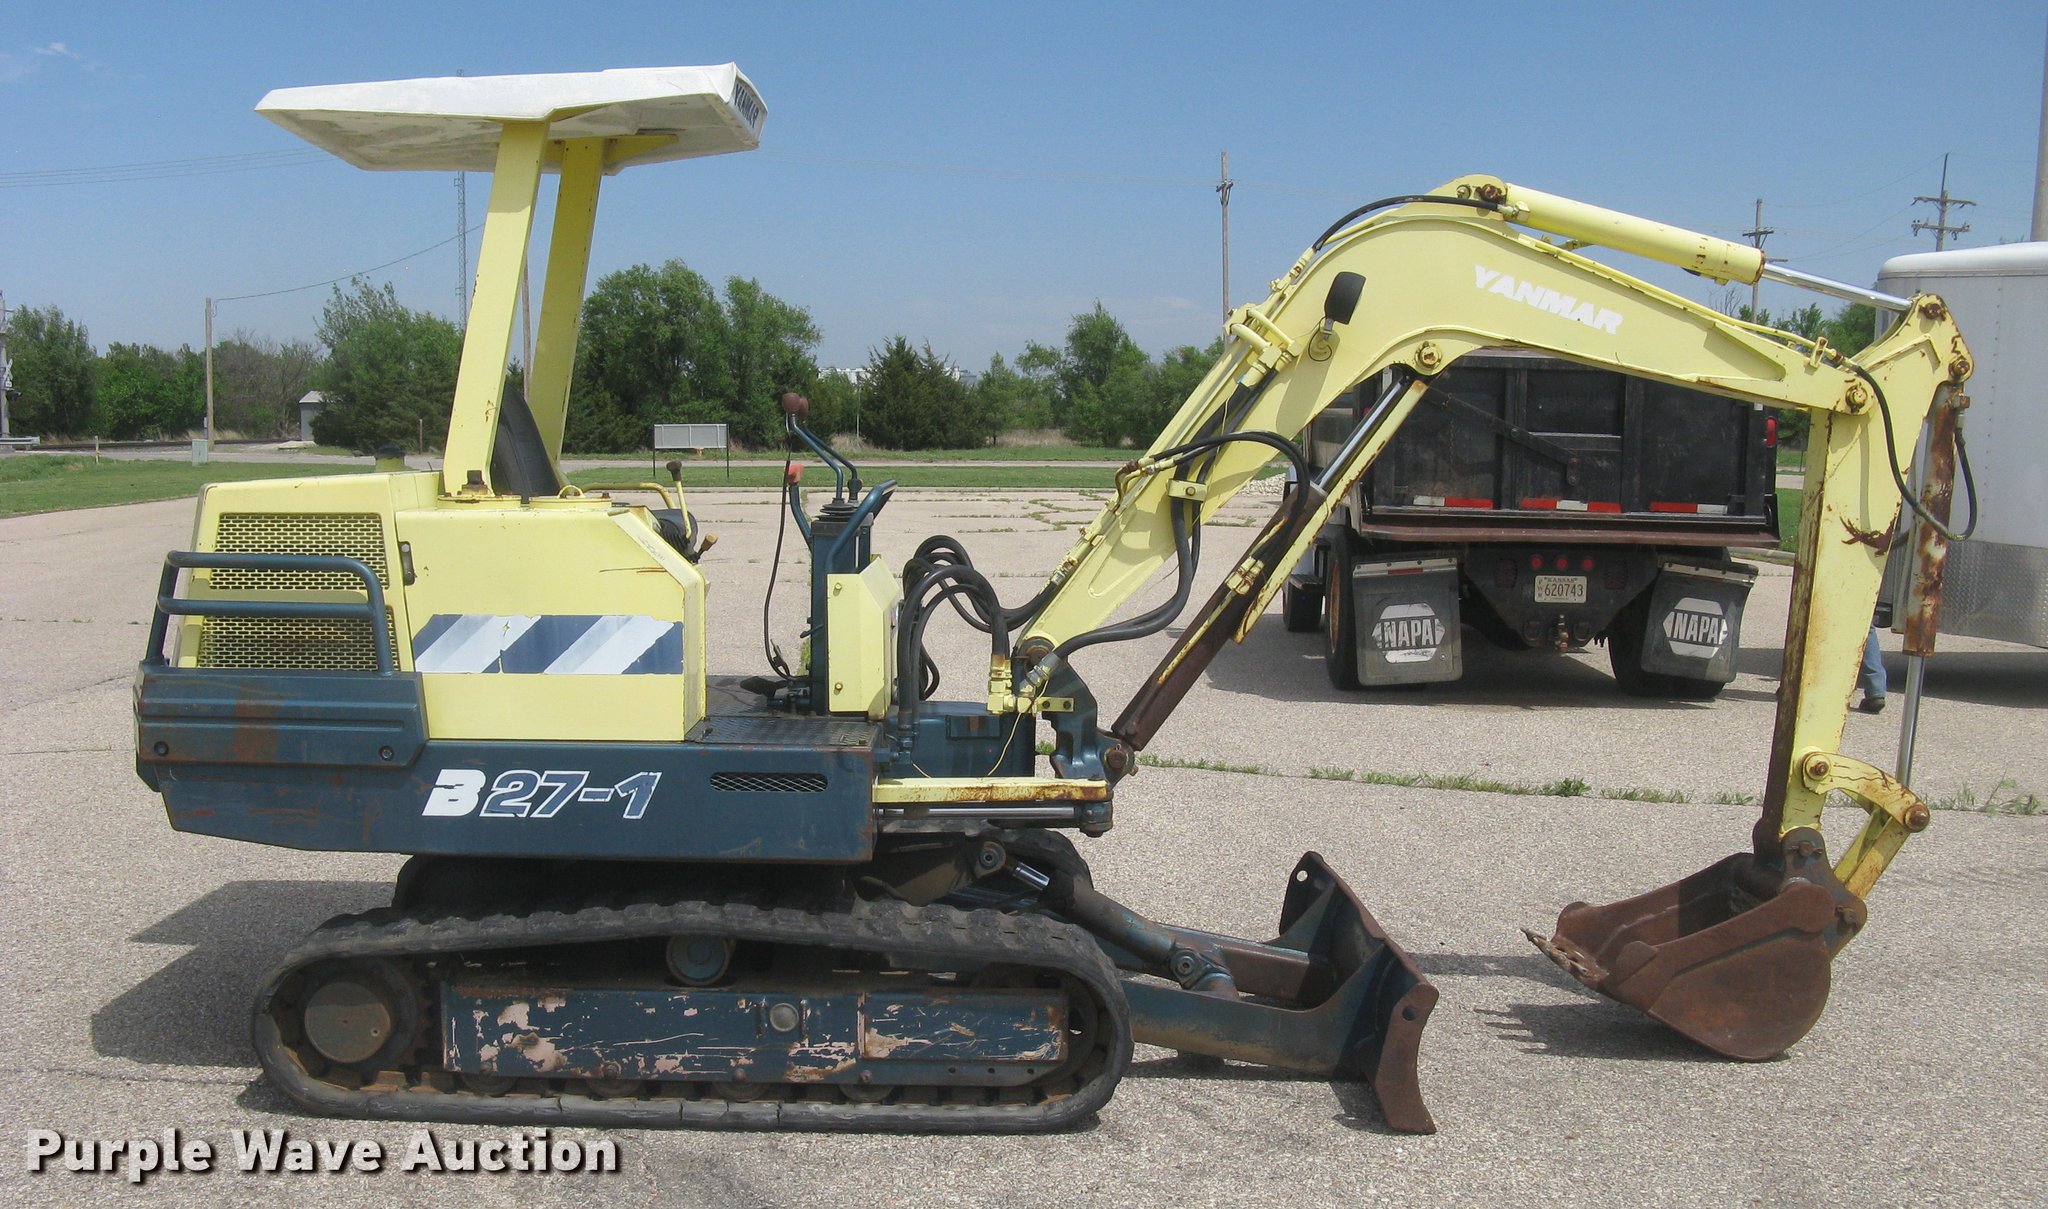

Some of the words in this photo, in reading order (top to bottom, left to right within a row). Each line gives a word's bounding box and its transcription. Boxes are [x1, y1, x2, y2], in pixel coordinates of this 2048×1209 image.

[1474, 264, 1624, 335] YANMAR
[1544, 583, 1584, 597] 620743
[1383, 618, 1434, 648] NAPA
[1673, 612, 1719, 645] NAPA
